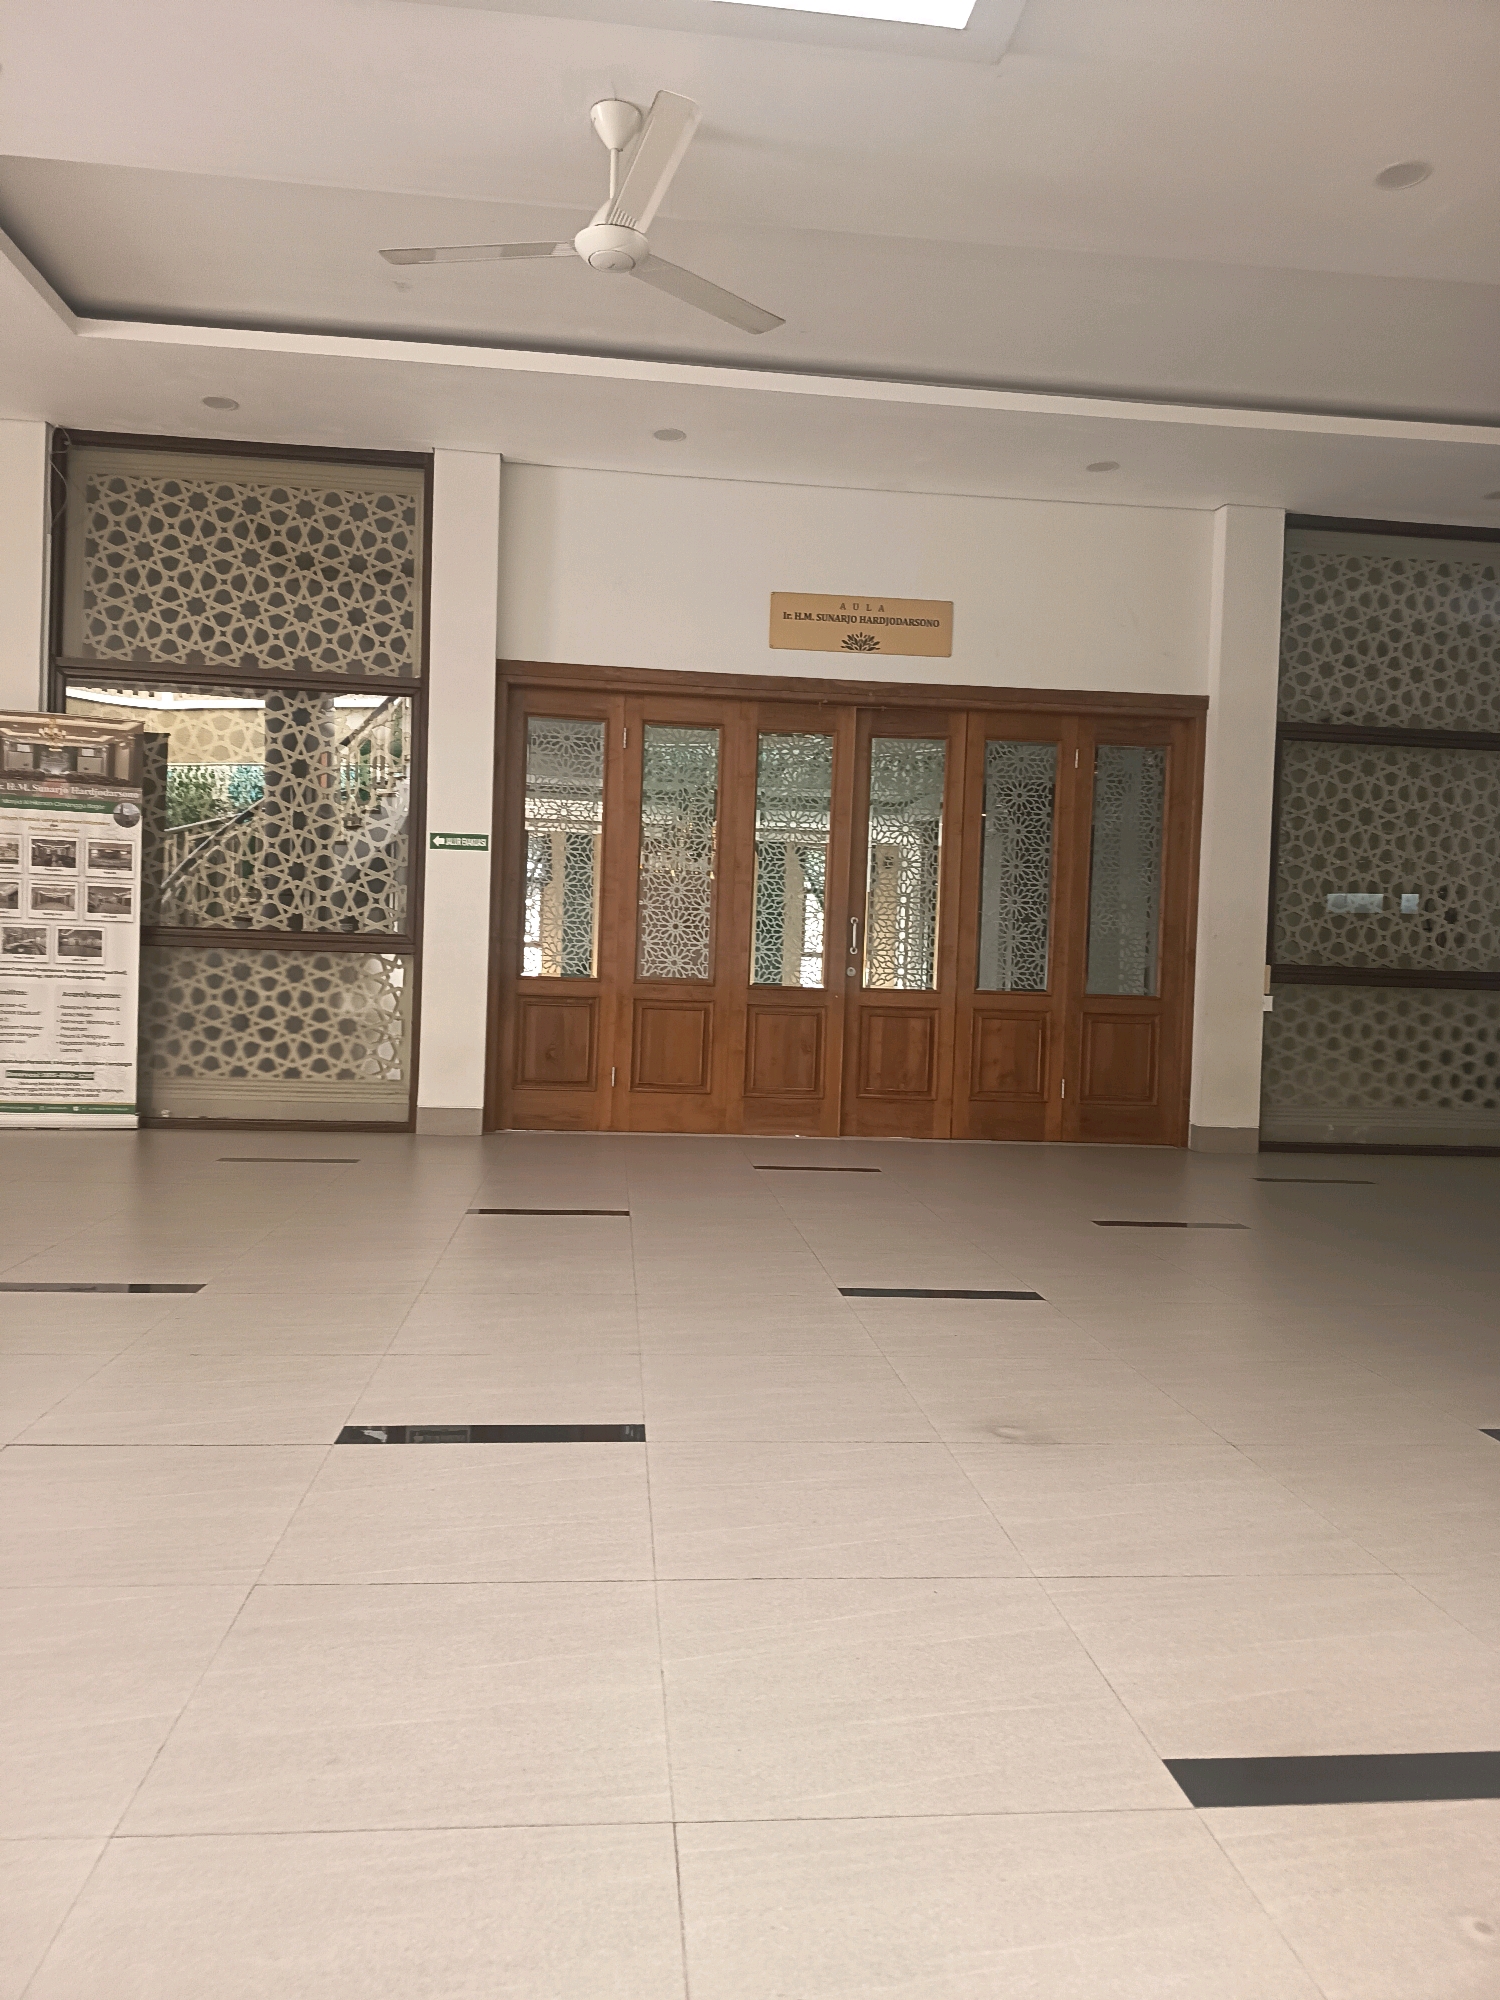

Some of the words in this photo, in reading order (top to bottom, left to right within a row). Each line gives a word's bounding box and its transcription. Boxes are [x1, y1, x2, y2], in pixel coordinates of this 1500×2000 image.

[839, 602, 885, 612] AULA
[782, 611, 793, 620] Ir.
[794, 612, 815, 621] H.M.
[816, 613, 858, 624] SUNARJO
[858, 615, 940, 628] HARDJODARSONO
